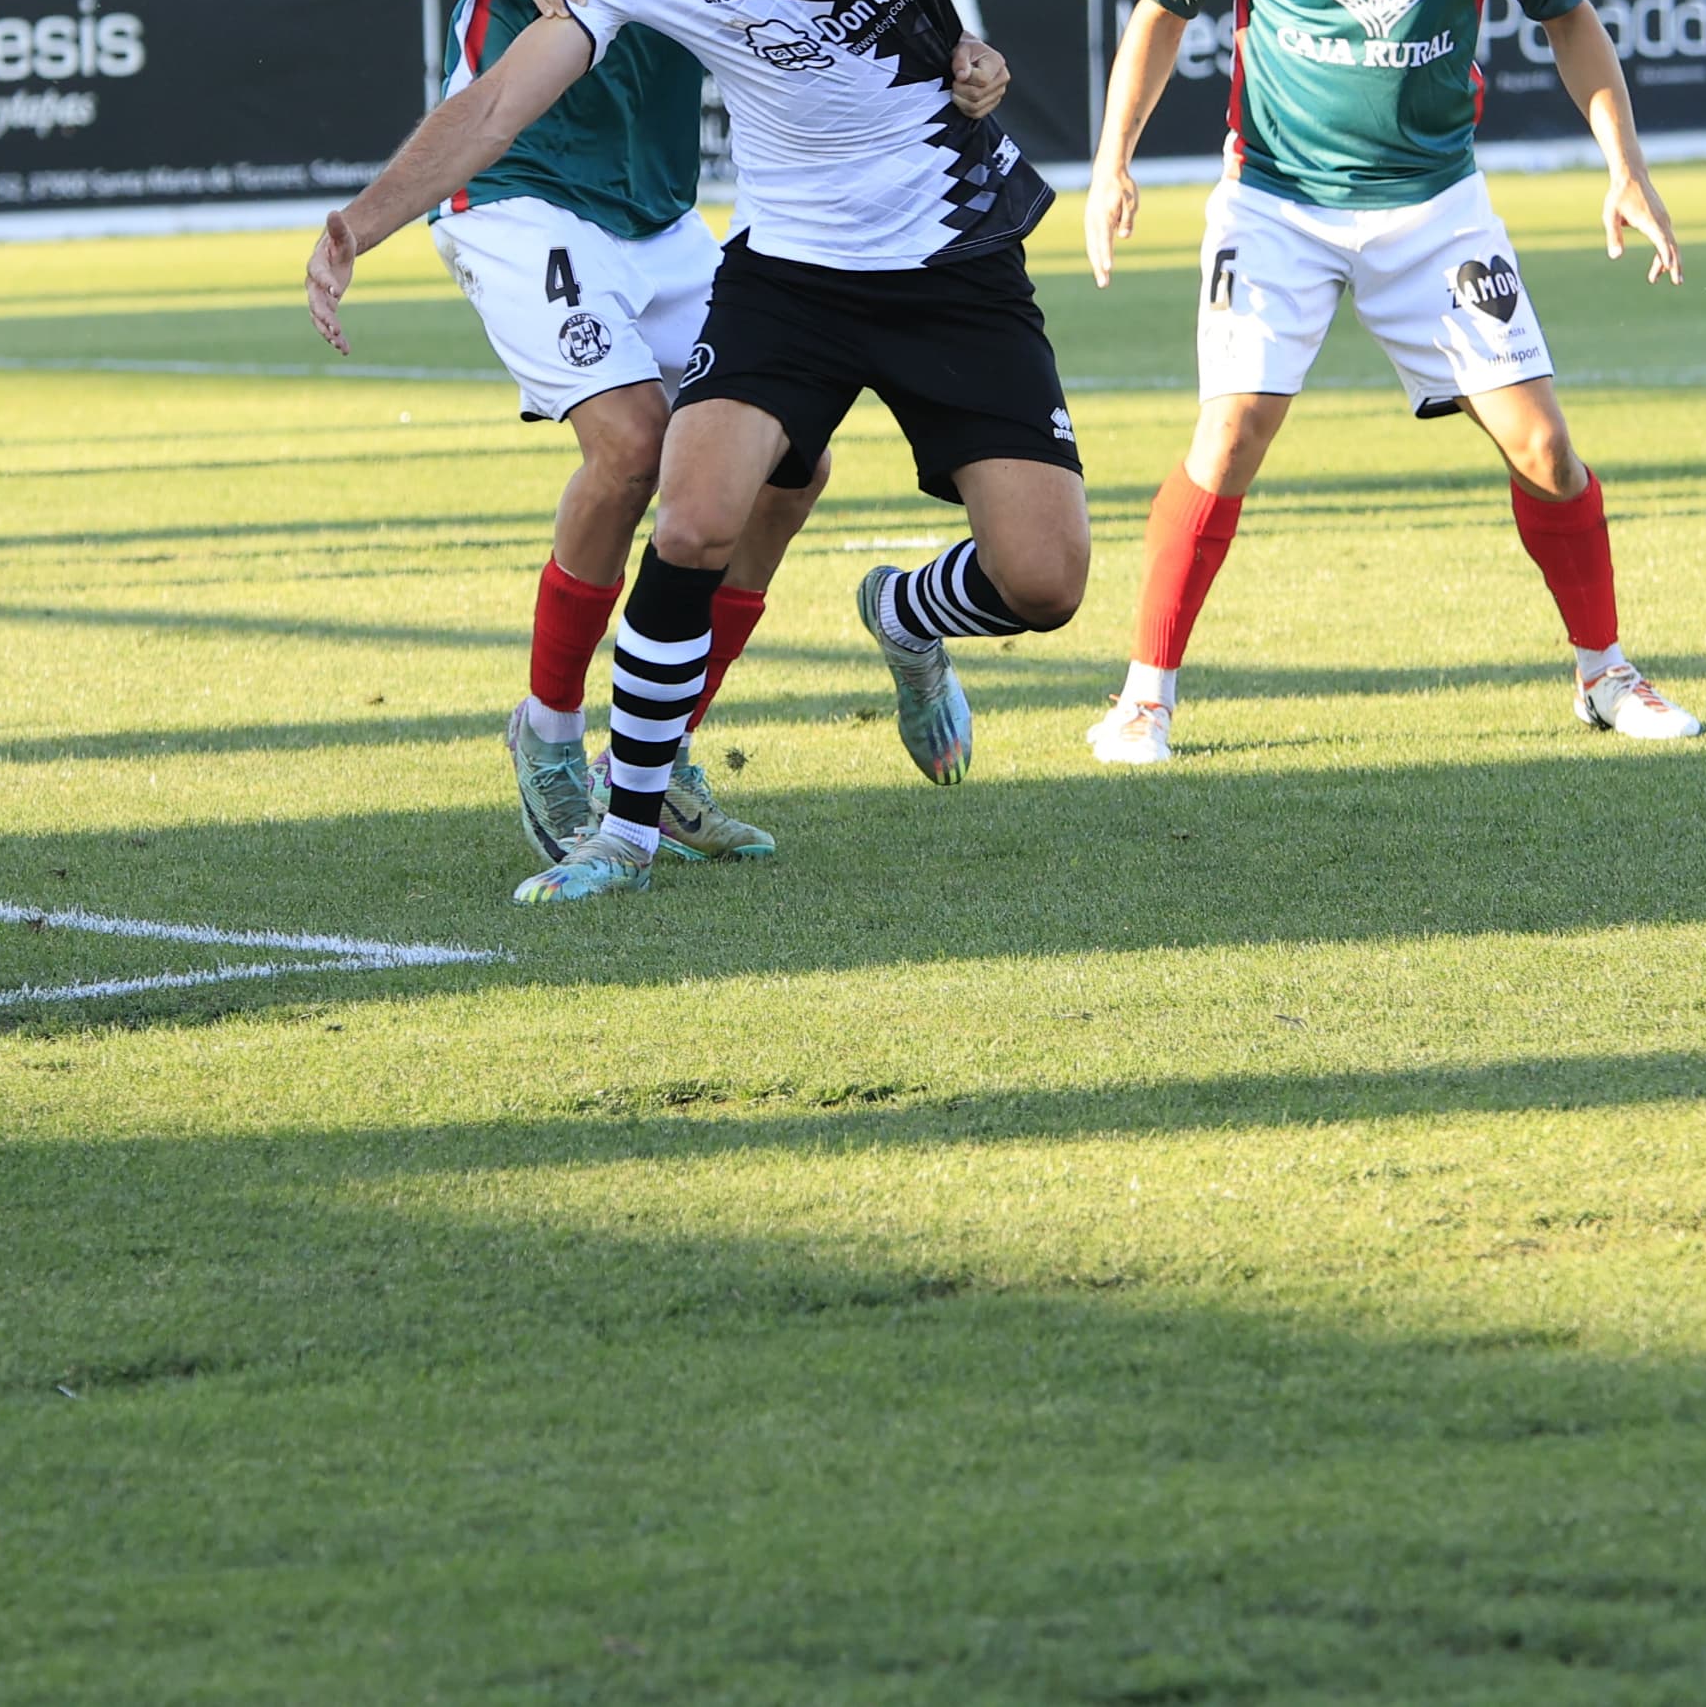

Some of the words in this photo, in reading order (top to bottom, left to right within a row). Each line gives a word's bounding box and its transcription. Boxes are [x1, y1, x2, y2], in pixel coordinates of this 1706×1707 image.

[813, 0, 877, 43] Don
[1276, 27, 1356, 67] CAJA
[1362, 30, 1454, 69] RURAL
[545, 247, 581, 308] 4
